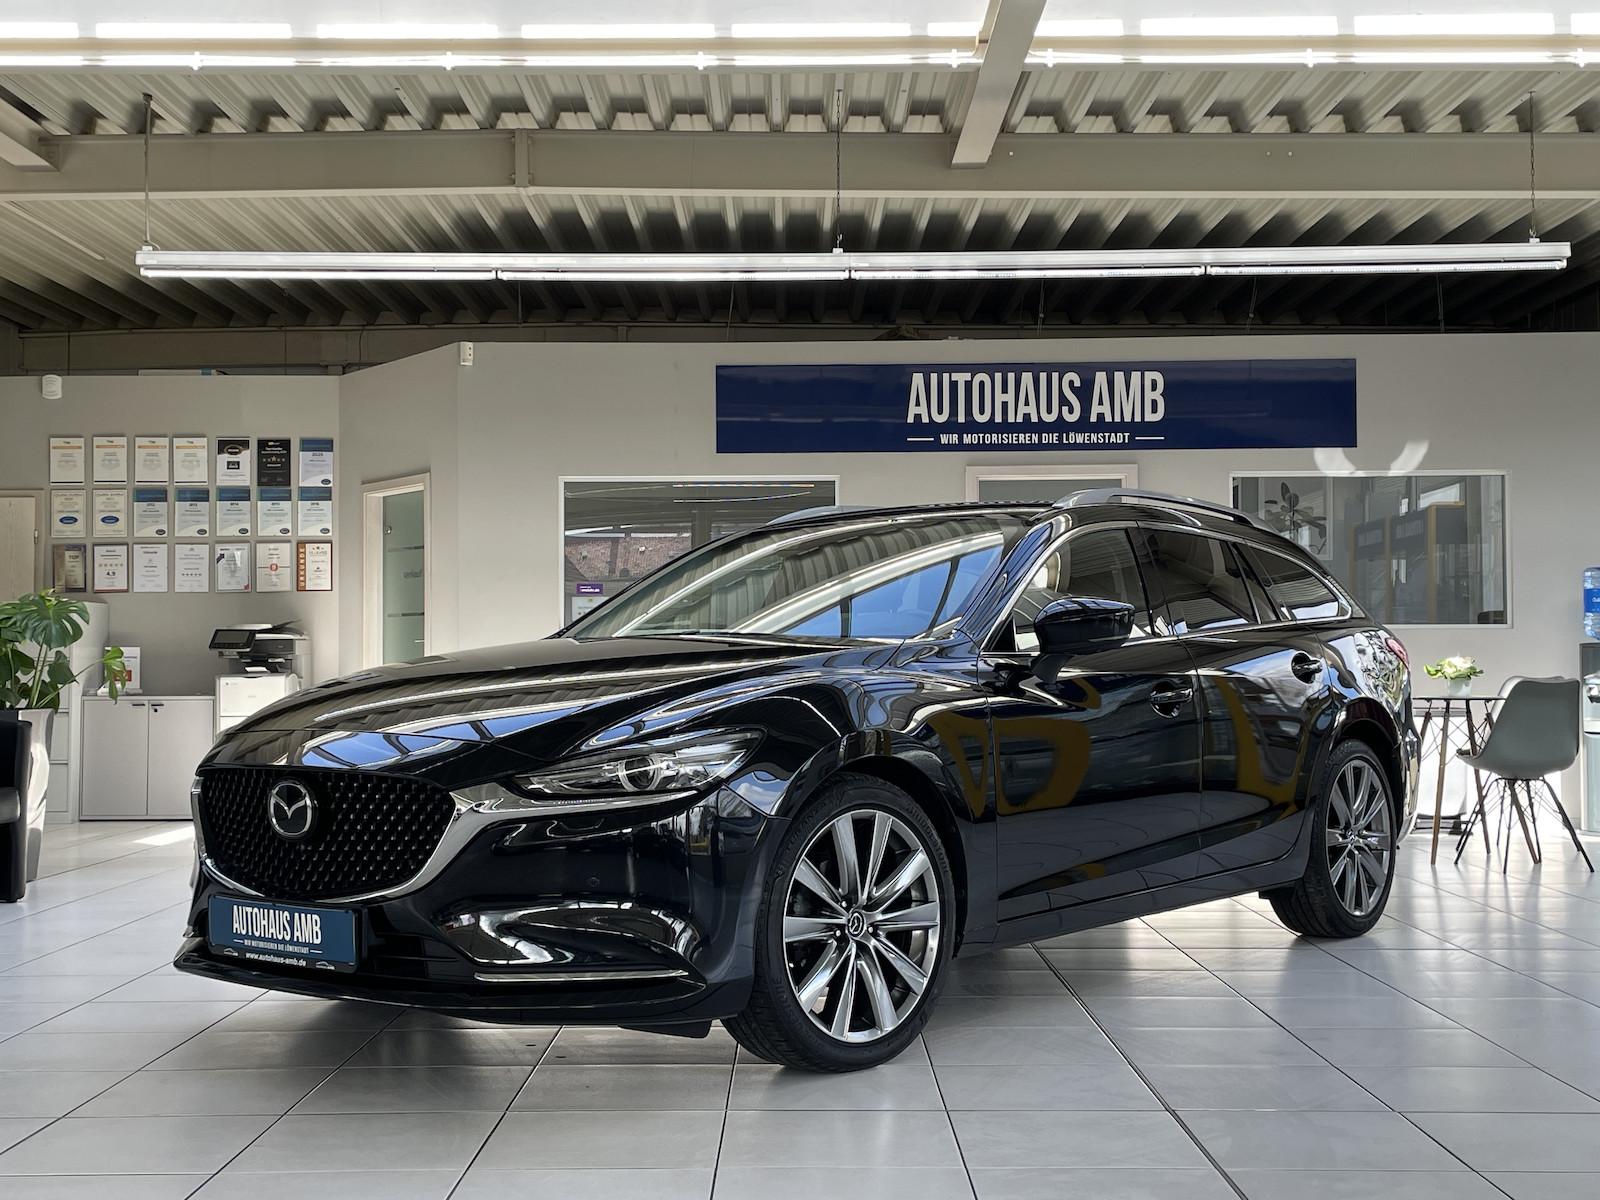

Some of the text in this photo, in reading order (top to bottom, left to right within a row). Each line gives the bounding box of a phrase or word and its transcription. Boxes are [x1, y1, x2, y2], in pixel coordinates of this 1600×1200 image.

[907, 371, 1165, 424] AUTOHAUS AMB
[940, 431, 1130, 445] WIR MOTORISIEREN DIE LÖWENSTADT
[232, 904, 322, 945] AUTOHAUS AMB
[245, 952, 307, 967] www.autohaus-amb.de
